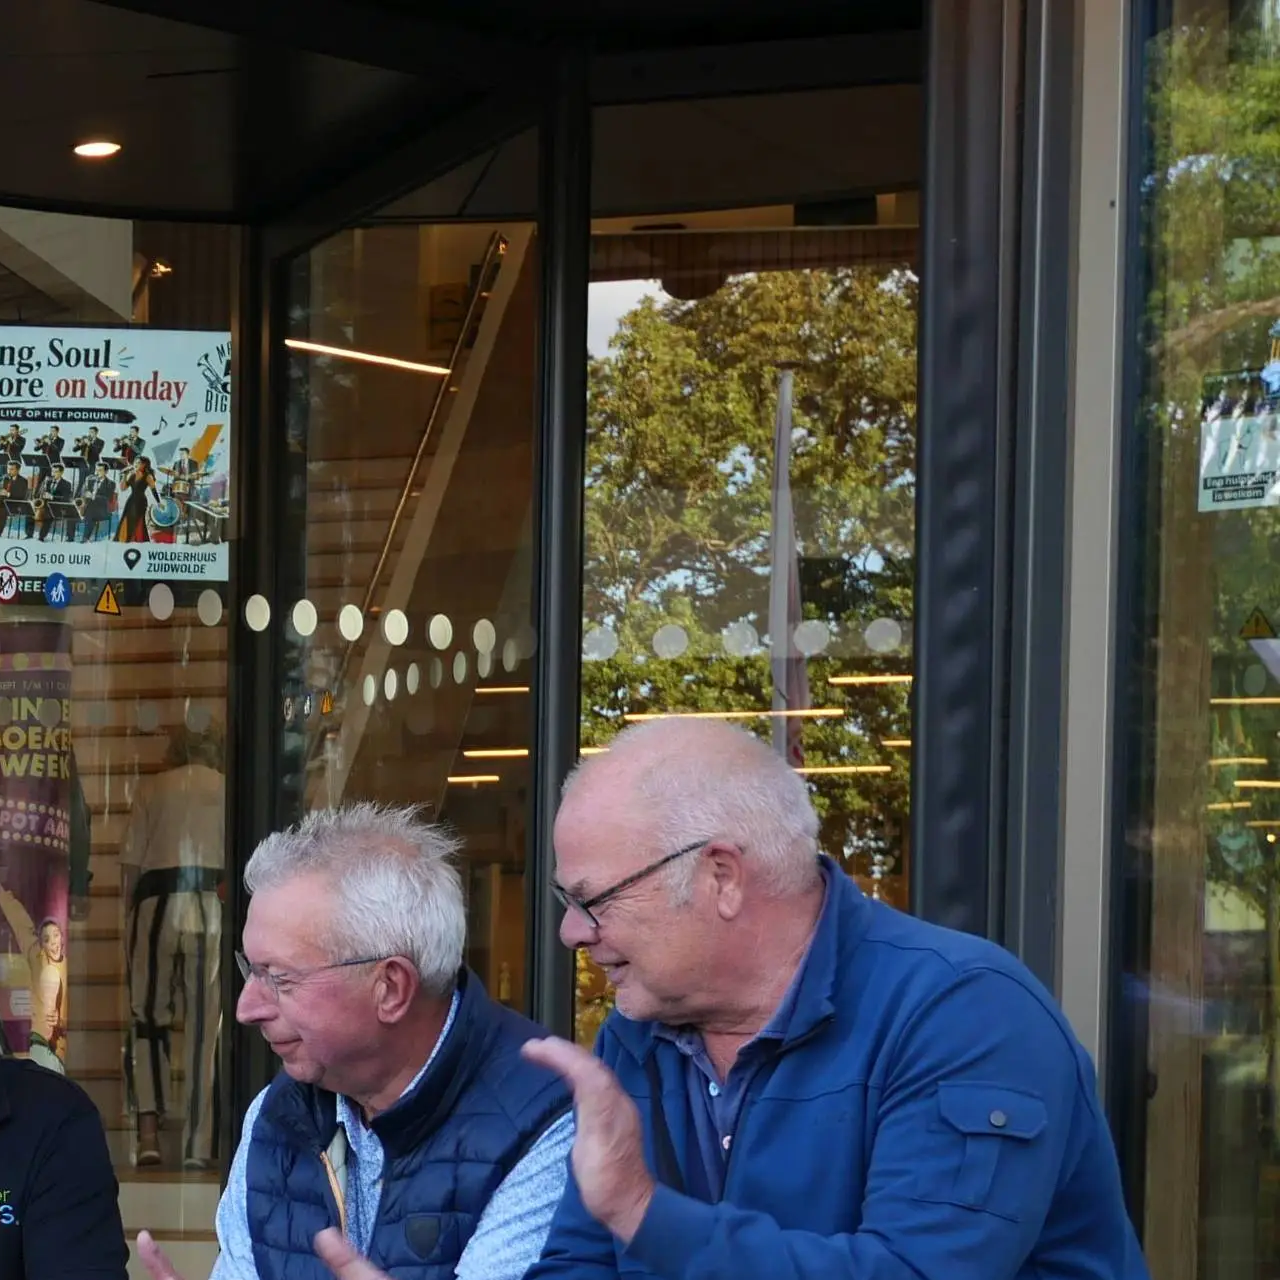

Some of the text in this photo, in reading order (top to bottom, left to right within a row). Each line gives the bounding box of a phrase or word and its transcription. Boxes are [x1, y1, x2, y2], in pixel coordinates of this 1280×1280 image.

[48, 338, 112, 368] Soul
[55, 378, 86, 398] on
[93, 371, 188, 408] Sunday
[0, 410, 114, 420] LIVE OP HET PODIUM!
[36, 553, 91, 565] 15.00 UUR
[148, 551, 217, 563] WOLDERHUUS
[146, 562, 206, 574] ZUIDWOLDE
